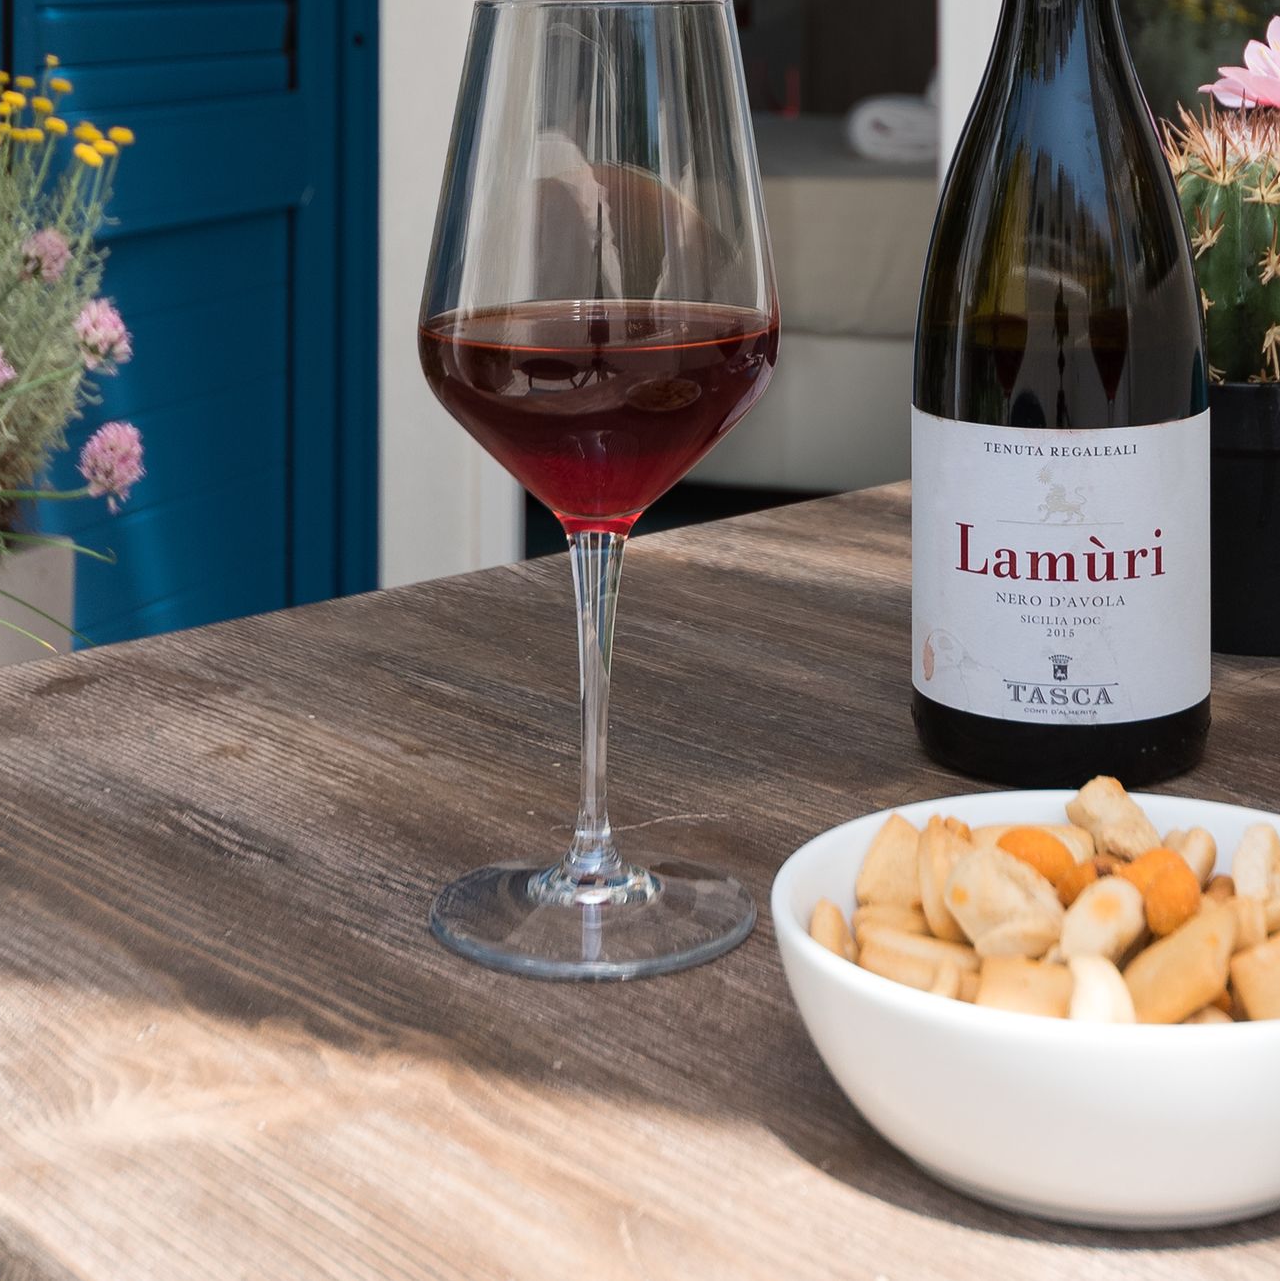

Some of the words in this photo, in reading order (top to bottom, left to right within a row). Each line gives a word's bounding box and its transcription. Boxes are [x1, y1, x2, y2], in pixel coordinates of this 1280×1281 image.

[984, 441, 1044, 457] TENUTA
[1050, 443, 1138, 457] REGALEALI
[955, 522, 1166, 582] Lamùri
[996, 592, 1042, 607] NERO
[1049, 594, 1125, 608] D'AVOLA
[1020, 613, 1068, 626] SICILIA
[1073, 616, 1101, 626] DOC
[1047, 628, 1075, 638] 2015
[1007, 685, 1114, 706] TASCA
[1023, 706, 1048, 715] CONTI
[1051, 708, 1098, 717] D'ALMERITA
